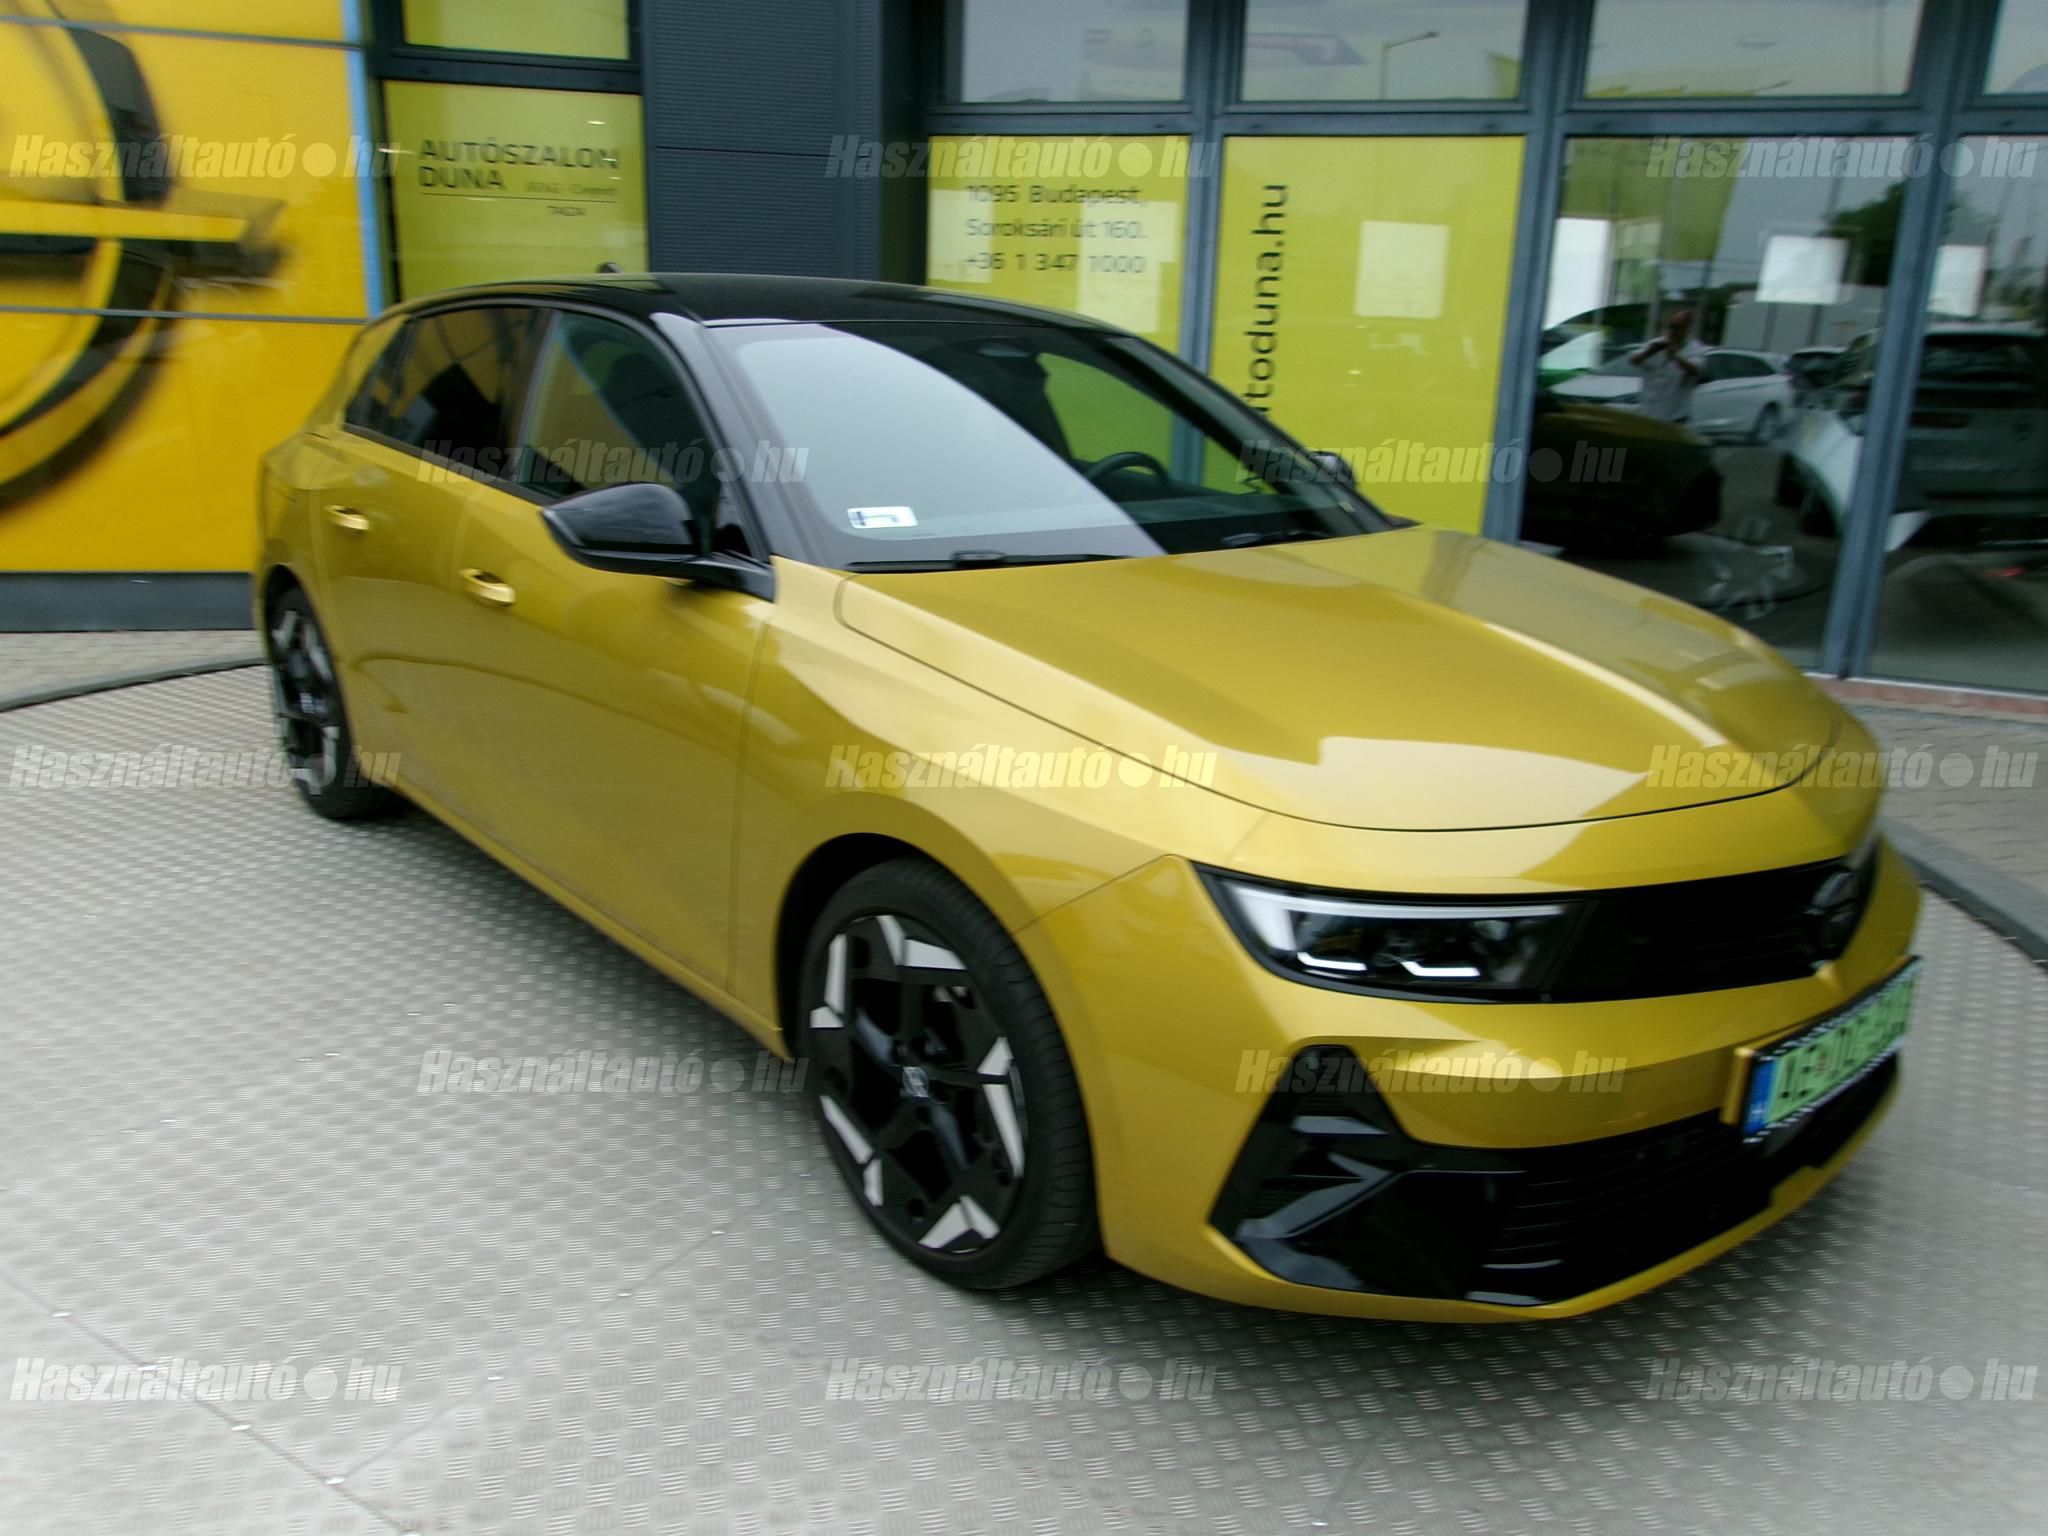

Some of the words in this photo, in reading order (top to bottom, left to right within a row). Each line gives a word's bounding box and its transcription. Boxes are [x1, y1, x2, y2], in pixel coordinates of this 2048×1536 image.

[419, 137, 620, 169] AUTÓSZALON
[419, 165, 507, 191] DUNA
[965, 185, 1020, 202] 1095
[965, 252, 1006, 270] +36
[1034, 253, 1080, 271] 347
[1087, 255, 1148, 273] 1000
